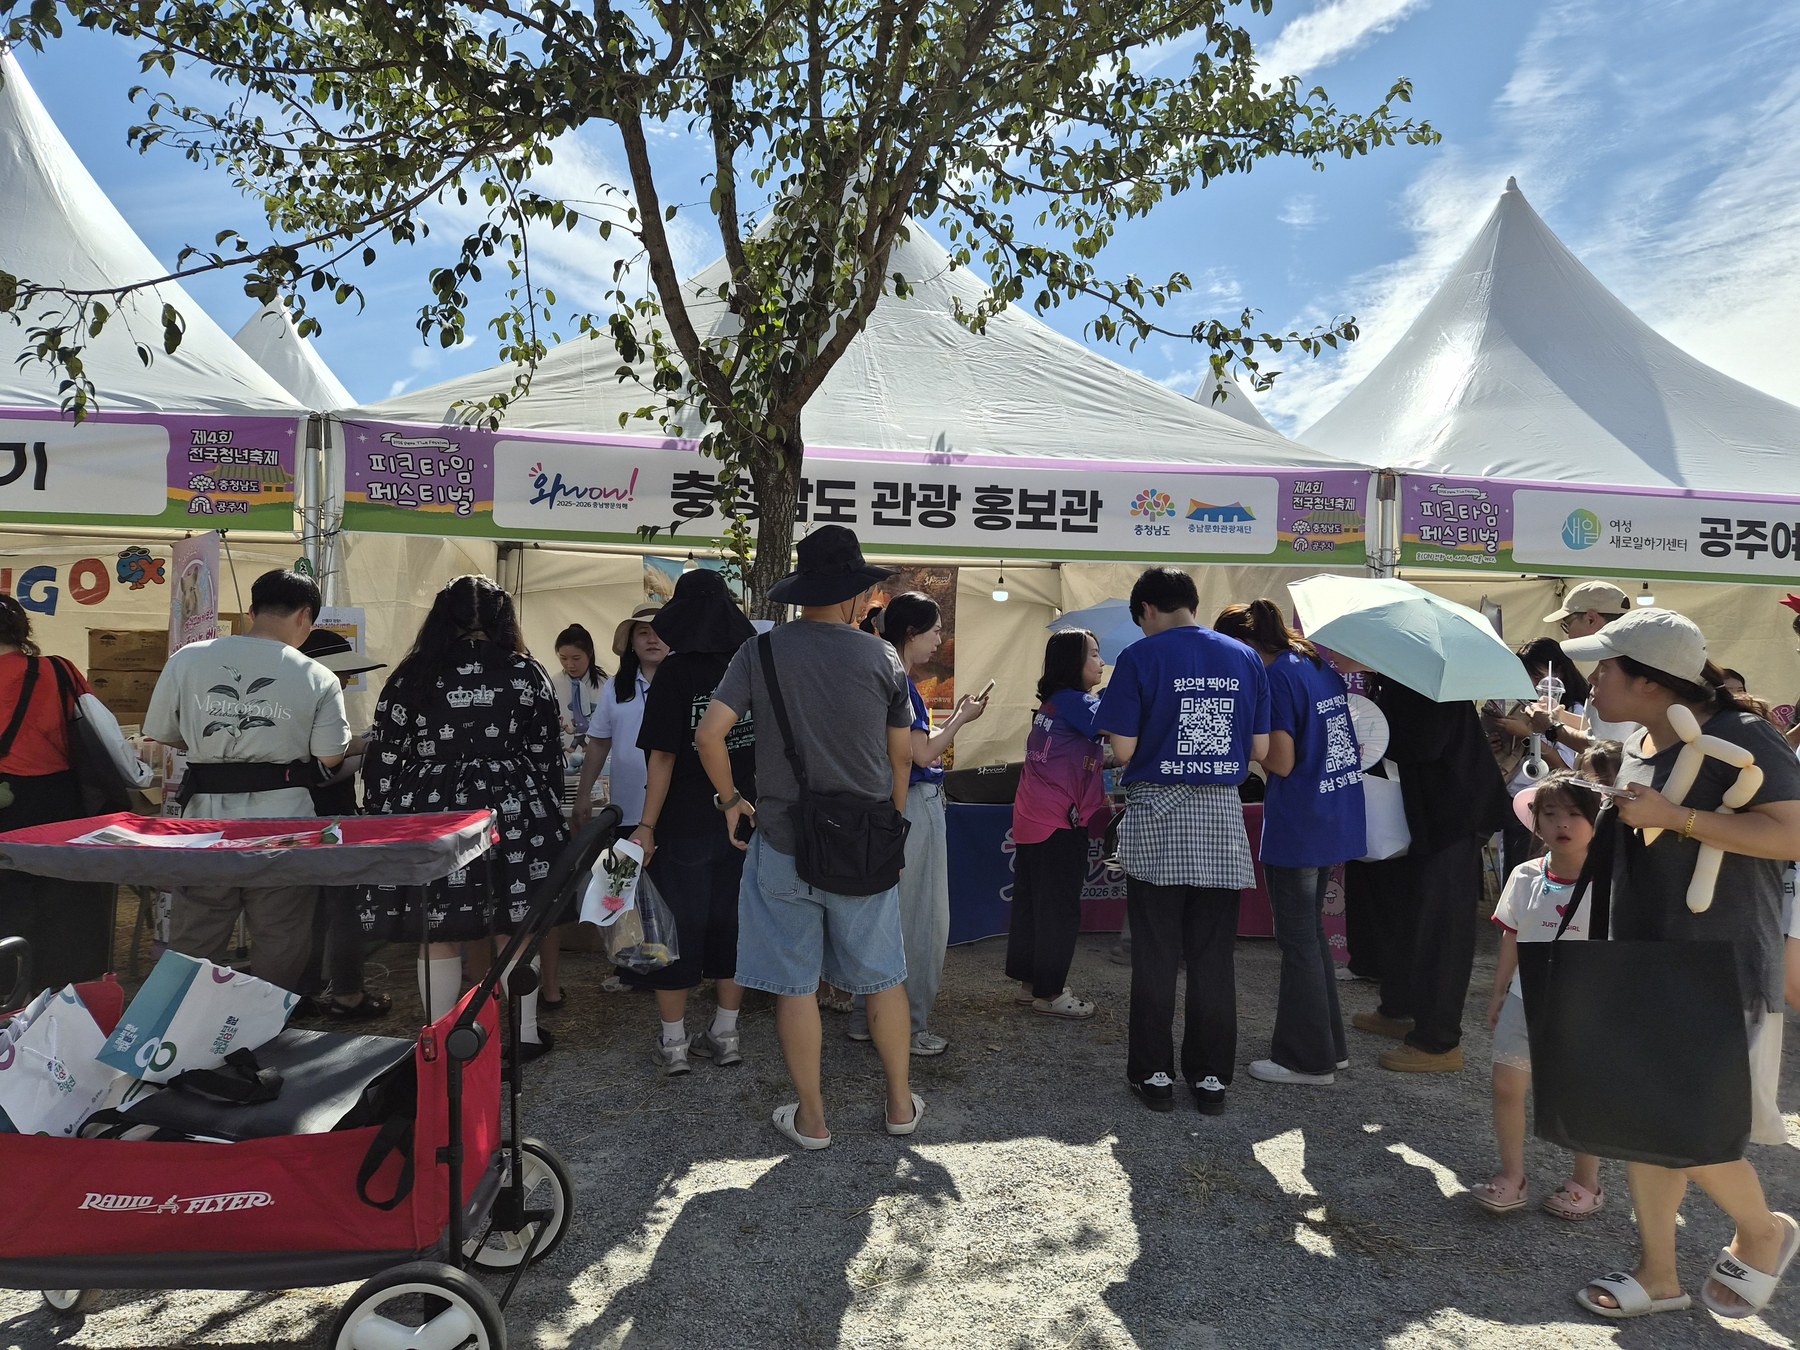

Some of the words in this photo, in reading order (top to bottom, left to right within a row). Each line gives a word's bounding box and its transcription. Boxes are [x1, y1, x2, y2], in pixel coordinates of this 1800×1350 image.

[191, 429, 233, 446] 제4회
[188, 447, 279, 466] 전국청년축제
[369, 453, 474, 485] 피크타임
[218, 478, 260, 493] 충청남도
[1294, 481, 1323, 495] 제4회
[367, 482, 474, 516] 페스티벌
[1292, 497, 1355, 512] 전국청년축제
[216, 500, 248, 514] 공주시
[871, 481, 961, 529] 관광
[971, 485, 1103, 533] 홍보관
[1420, 500, 1499, 527] 피크타임
[1134, 525, 1171, 536] 충청남도
[1188, 524, 1252, 535] 충남문화관광재단
[1312, 523, 1341, 535] 충청남도
[1562, 515, 1600, 546] 새일
[1609, 520, 1633, 534] 여성
[1311, 541, 1334, 551] 공주시
[1419, 525, 1499, 554] 페스티벌
[1609, 536, 1688, 551] 새로일하기센터
[1173, 677, 1205, 692] 왔으면
[1206, 677, 1240, 691] 찍어요
[1160, 760, 1185, 774] 충남
[1186, 762, 1212, 773] SNS
[1213, 761, 1240, 775] 팔로우
[1319, 779, 1335, 793] 충남
[1349, 770, 1368, 784] 팔로
[77, 1193, 157, 1211] RADIO
[178, 1191, 272, 1214] FLYER
[1721, 1259, 1748, 1278] NIKE
